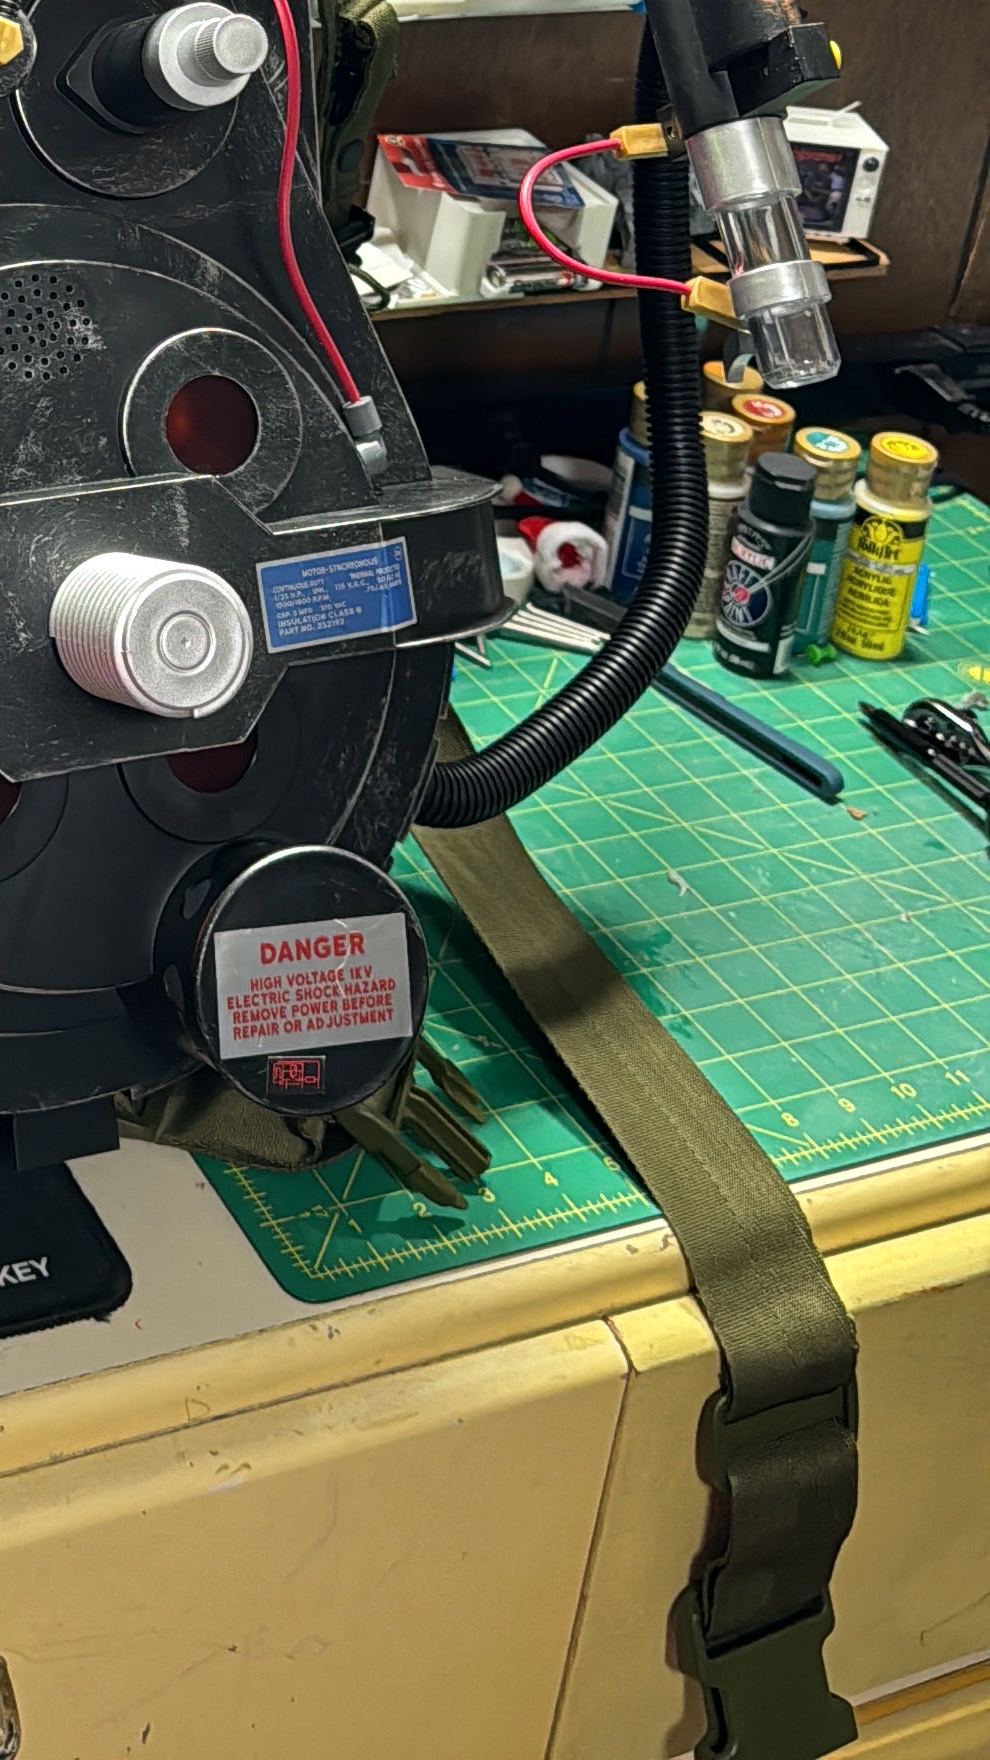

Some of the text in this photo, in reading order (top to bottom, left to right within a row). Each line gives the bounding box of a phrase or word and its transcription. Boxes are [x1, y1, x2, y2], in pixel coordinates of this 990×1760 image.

[278, 614, 327, 628] INSULATION
[329, 607, 355, 619] CLASS
[278, 627, 299, 637] PART
[260, 932, 365, 965] DANGER
[227, 978, 396, 1010] ELECTRIC SHOCK HAZARD
[250, 965, 373, 992] HIGH VOLTAGE 1KV
[232, 993, 392, 1024] REMOVE POWER BEFORE
[233, 1008, 394, 1041] REPAIR OR ADJUSTMENT
[413, 1202, 432, 1217] 2
[478, 1187, 496, 1203] 3
[543, 1171, 559, 1186] 4
[604, 1155, 622, 1171] 5
[781, 1112, 800, 1127] 8
[838, 1097, 856, 1113] 9
[890, 1083, 917, 1099] 10
[945, 1069, 970, 1085] 11
